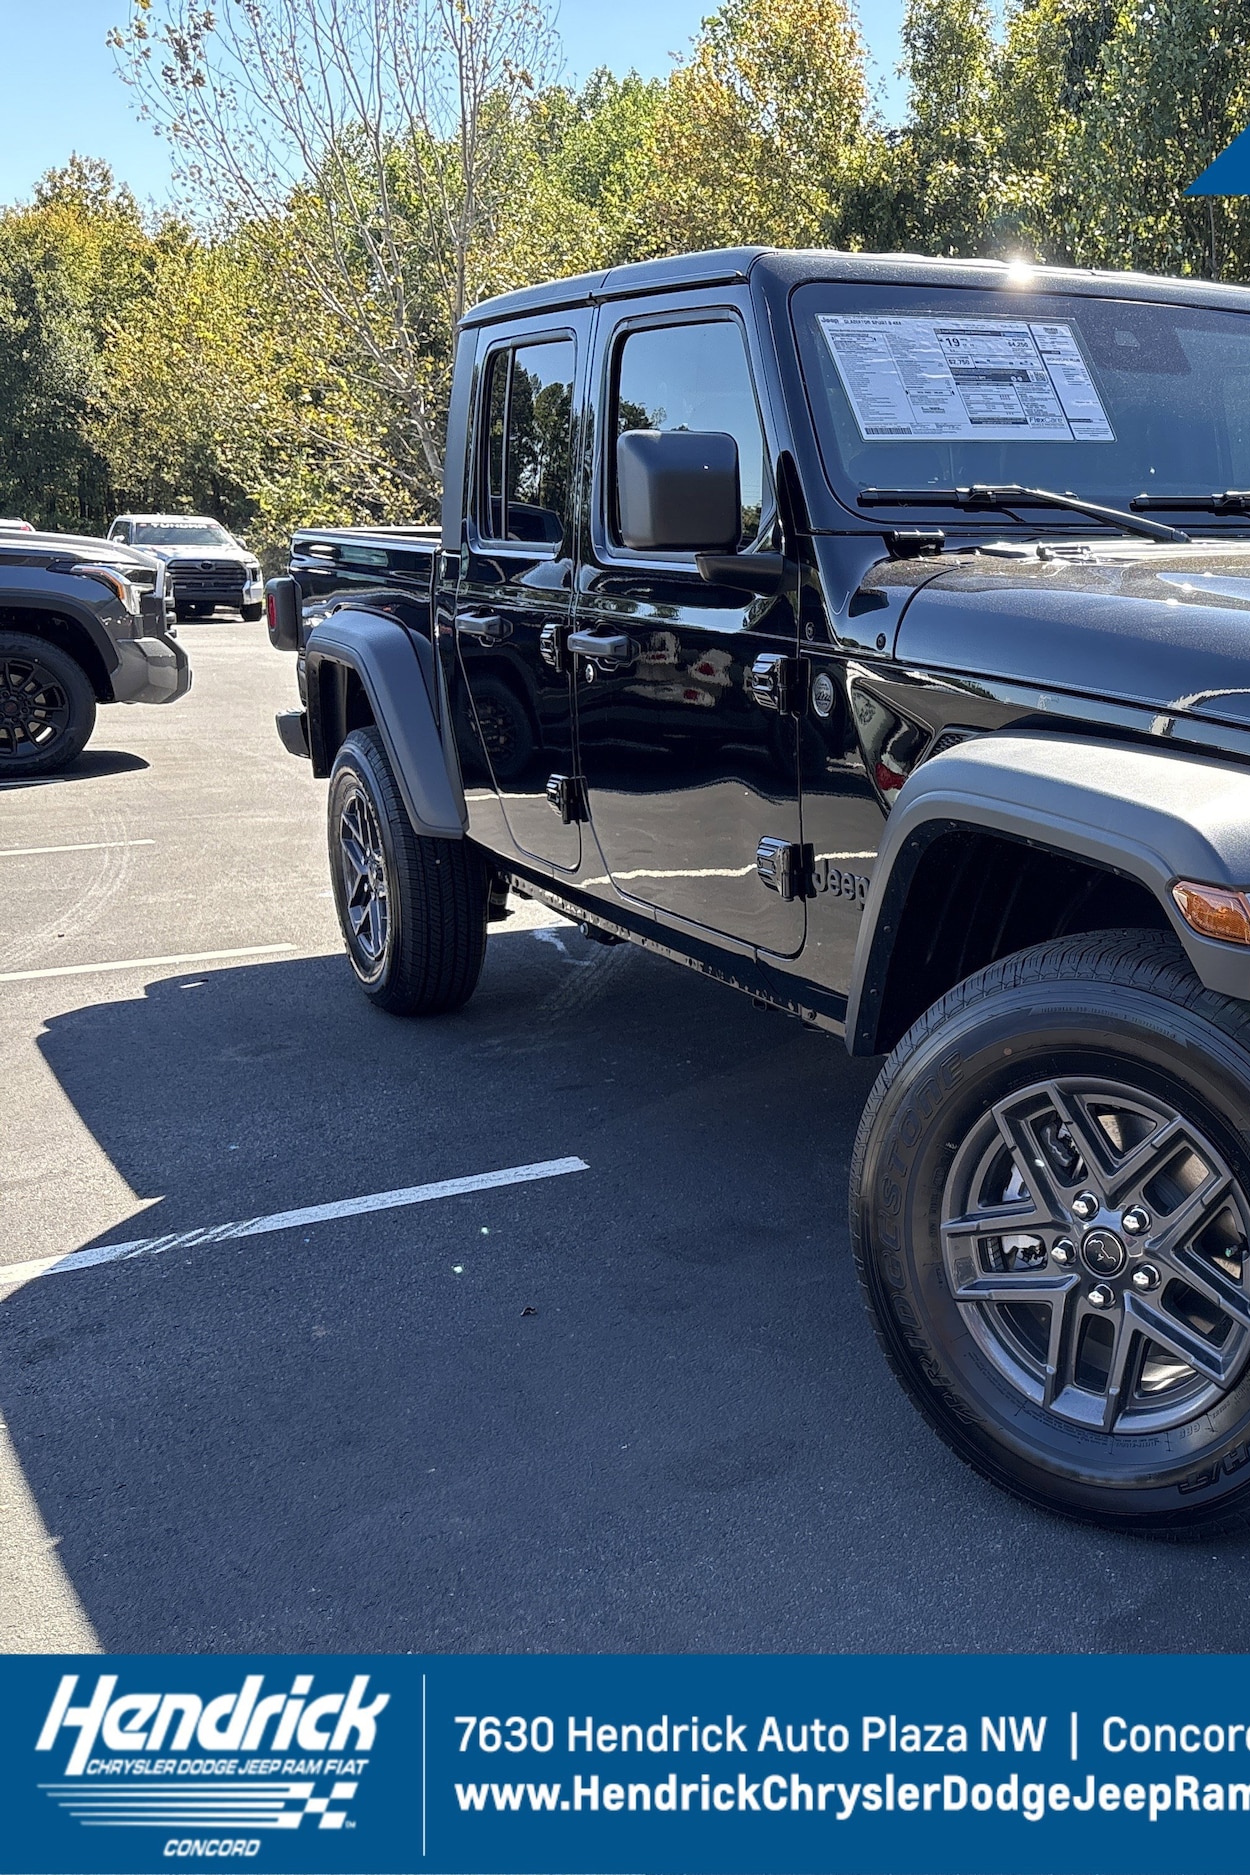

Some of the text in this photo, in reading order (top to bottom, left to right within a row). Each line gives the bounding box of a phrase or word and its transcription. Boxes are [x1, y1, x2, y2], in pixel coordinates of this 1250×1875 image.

[821, 316, 840, 325] Jeep
[946, 337, 961, 347] 19
[1028, 416, 1064, 424] FlexCare
[812, 857, 871, 912] Jeep
[878, 1050, 981, 1427] BRIDGESTONE
